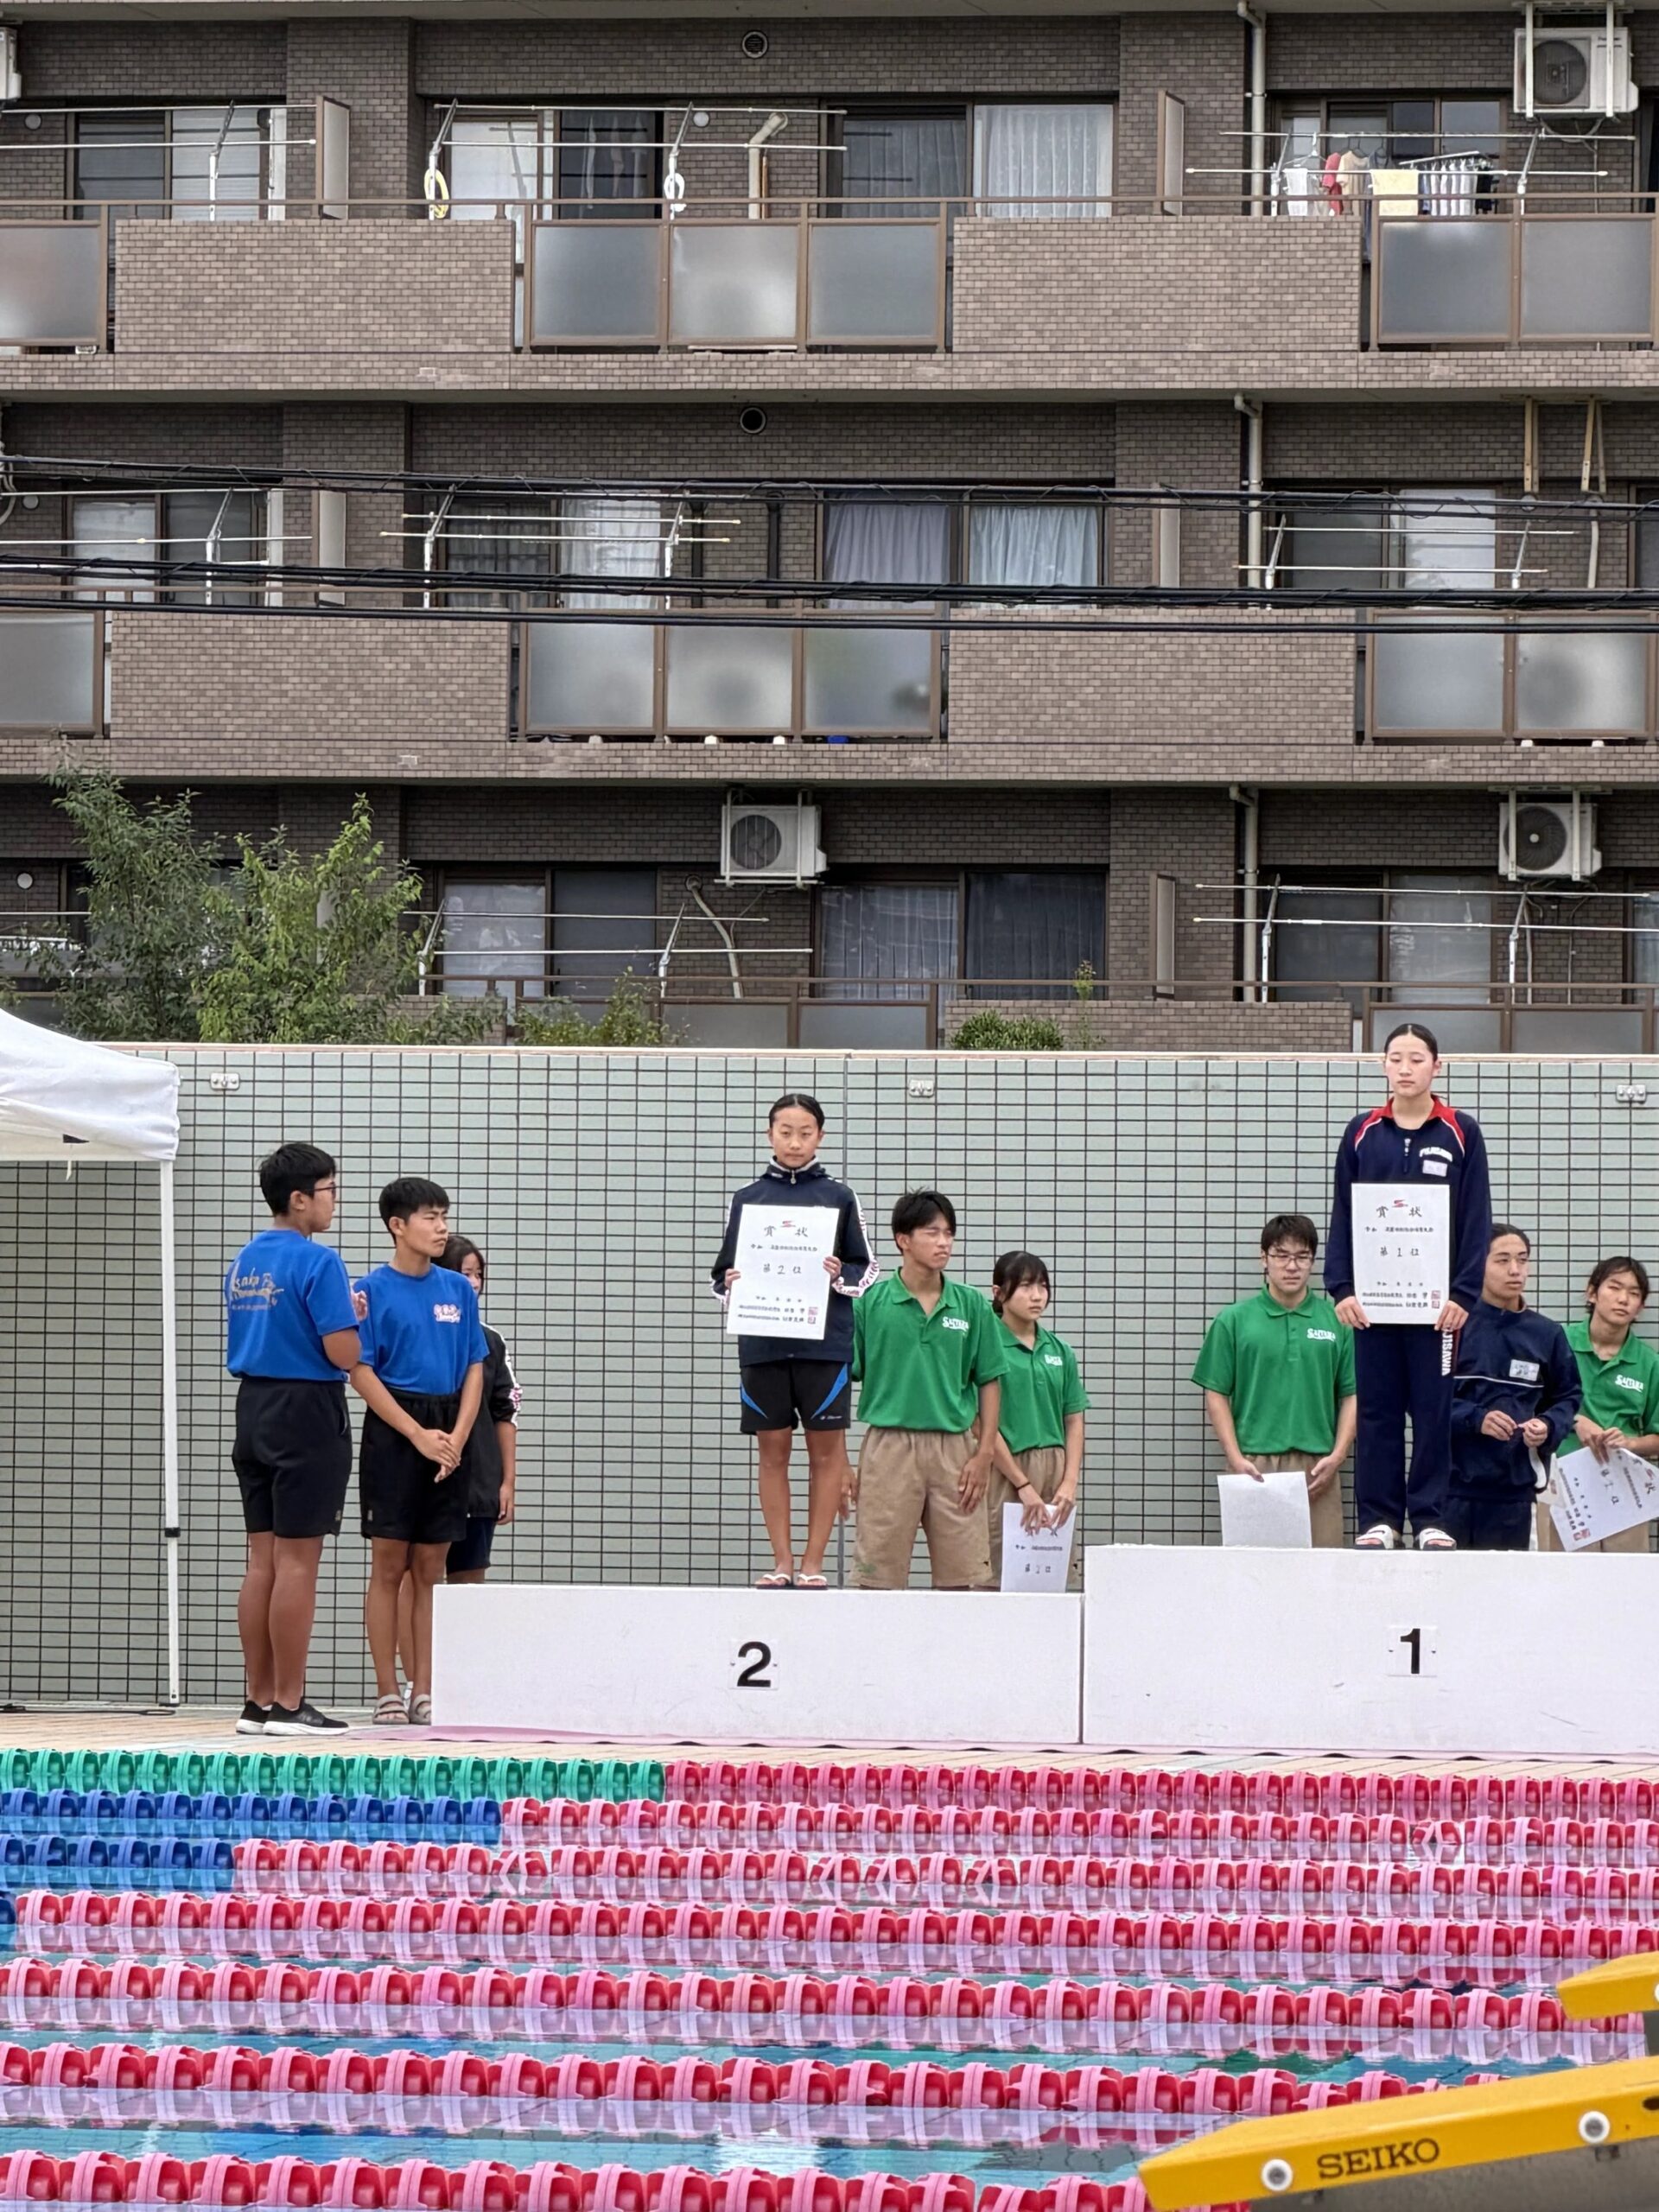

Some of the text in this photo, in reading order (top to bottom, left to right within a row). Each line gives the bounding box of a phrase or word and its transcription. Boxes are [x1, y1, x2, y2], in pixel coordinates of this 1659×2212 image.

[737, 1641, 772, 1688] 2
[1401, 1628, 1421, 1675] 1
[1317, 2137, 1440, 2179] SEIKO
